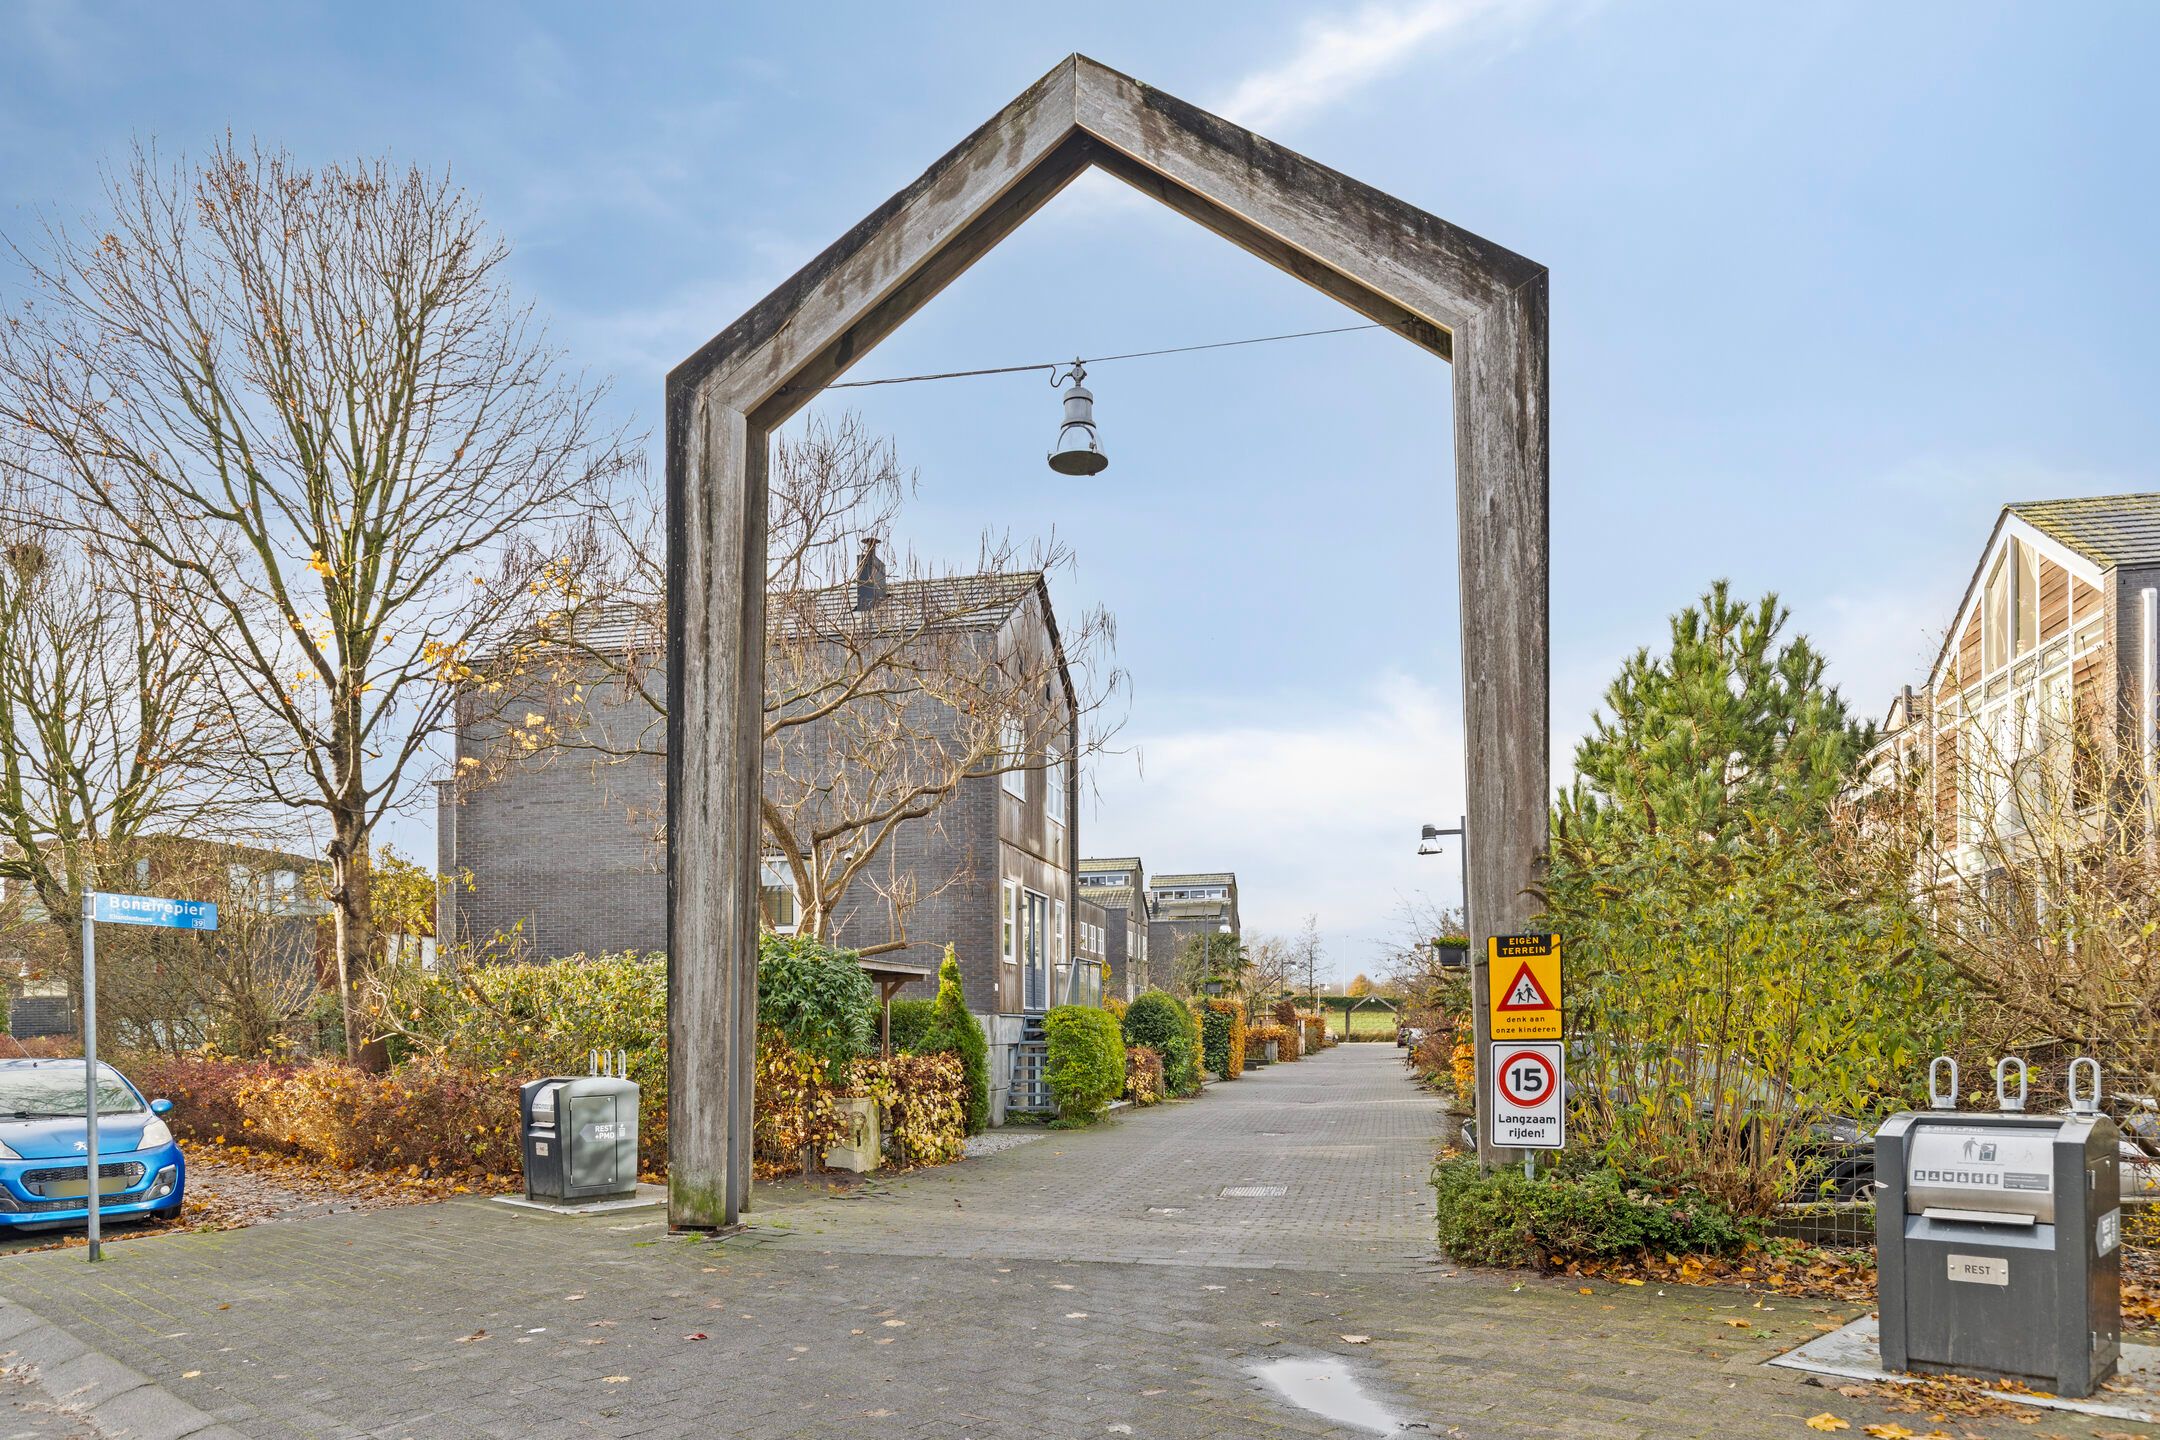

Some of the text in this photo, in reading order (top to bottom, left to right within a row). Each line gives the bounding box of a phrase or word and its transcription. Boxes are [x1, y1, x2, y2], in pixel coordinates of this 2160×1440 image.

[110, 896, 205, 916] Bonairepier
[193, 919, 204, 928] 39
[1509, 936, 1539, 945] EIGEN
[1502, 946, 1546, 955] TERREIN
[1518, 1026, 1557, 1034] kinderen
[1511, 1068, 1543, 1092] 15
[1498, 1113, 1557, 1126] Langzaam
[1508, 1128, 1545, 1140] rijden!
[1964, 1264, 1991, 1275] REST
